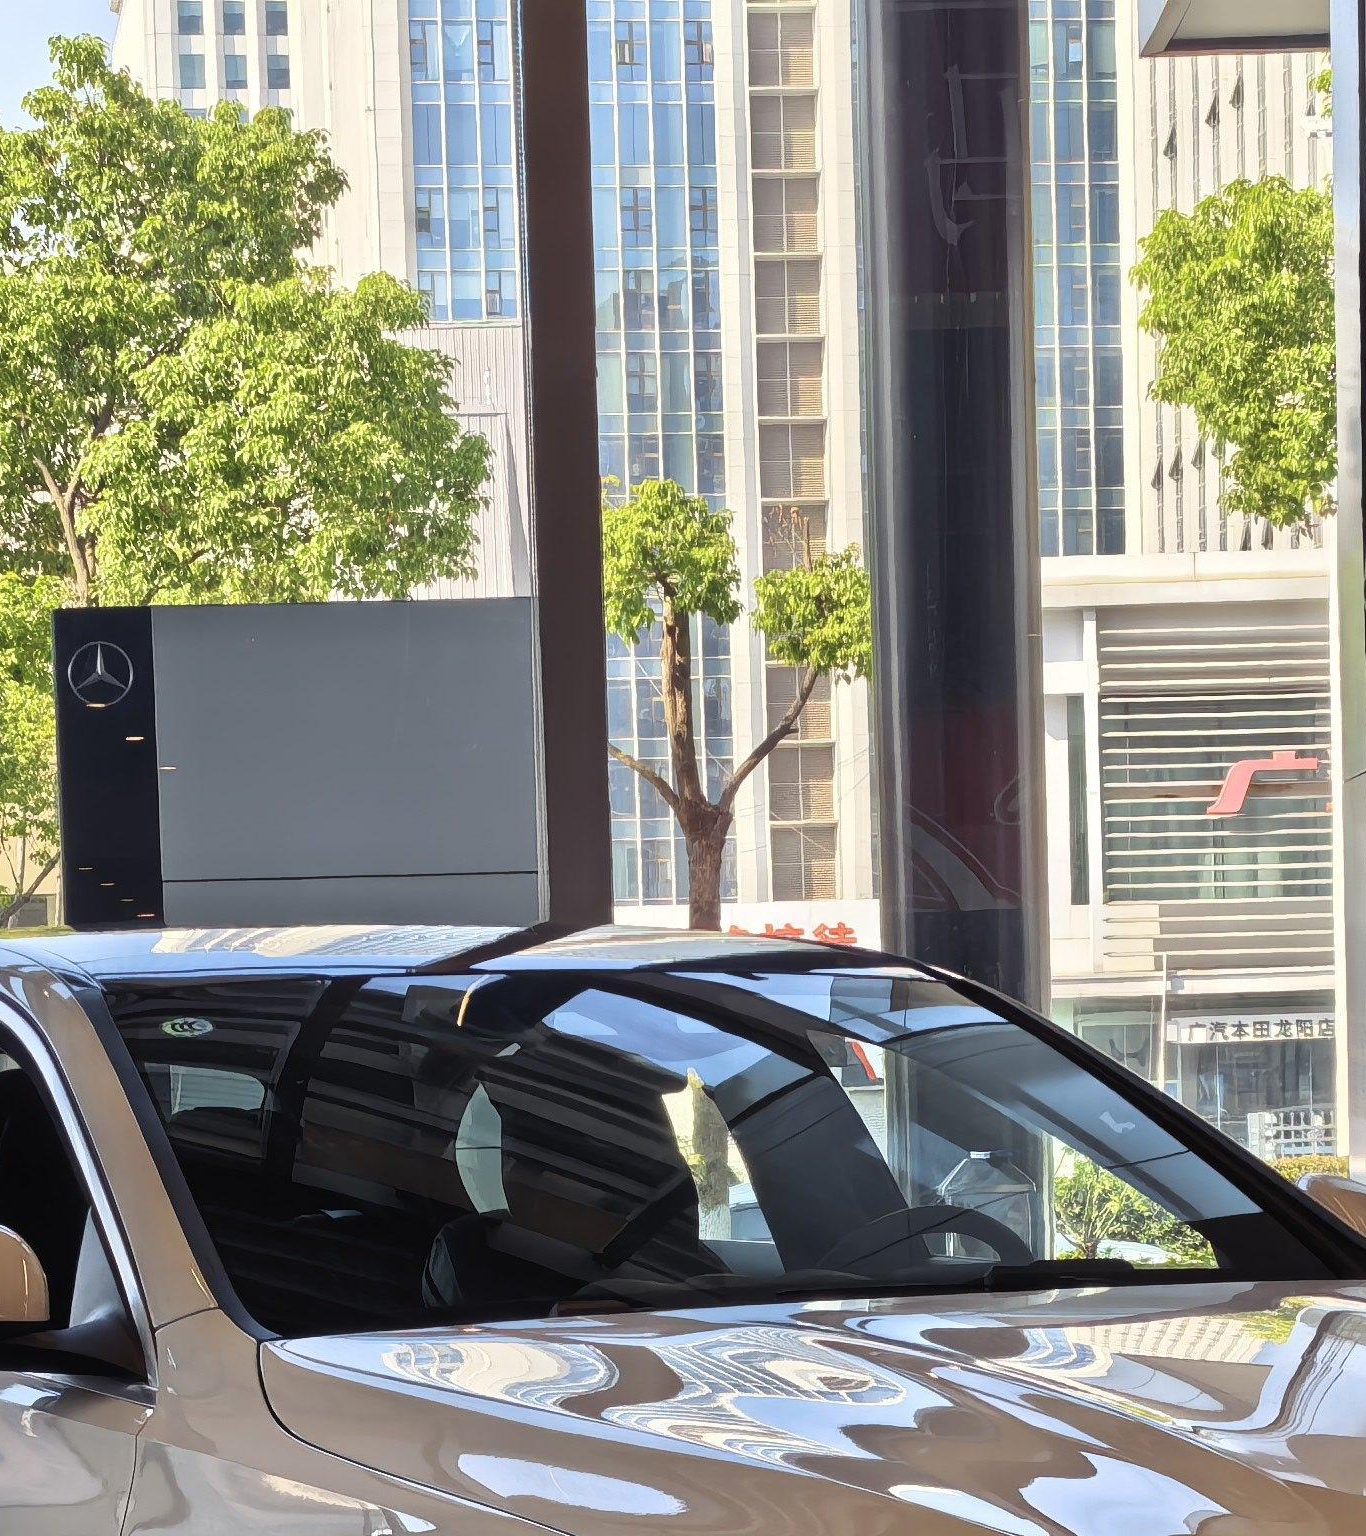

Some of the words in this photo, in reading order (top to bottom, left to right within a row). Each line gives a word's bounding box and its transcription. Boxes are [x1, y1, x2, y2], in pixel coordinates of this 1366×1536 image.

[1188, 1018, 1335, 1042] 广汽本田龙阳店
